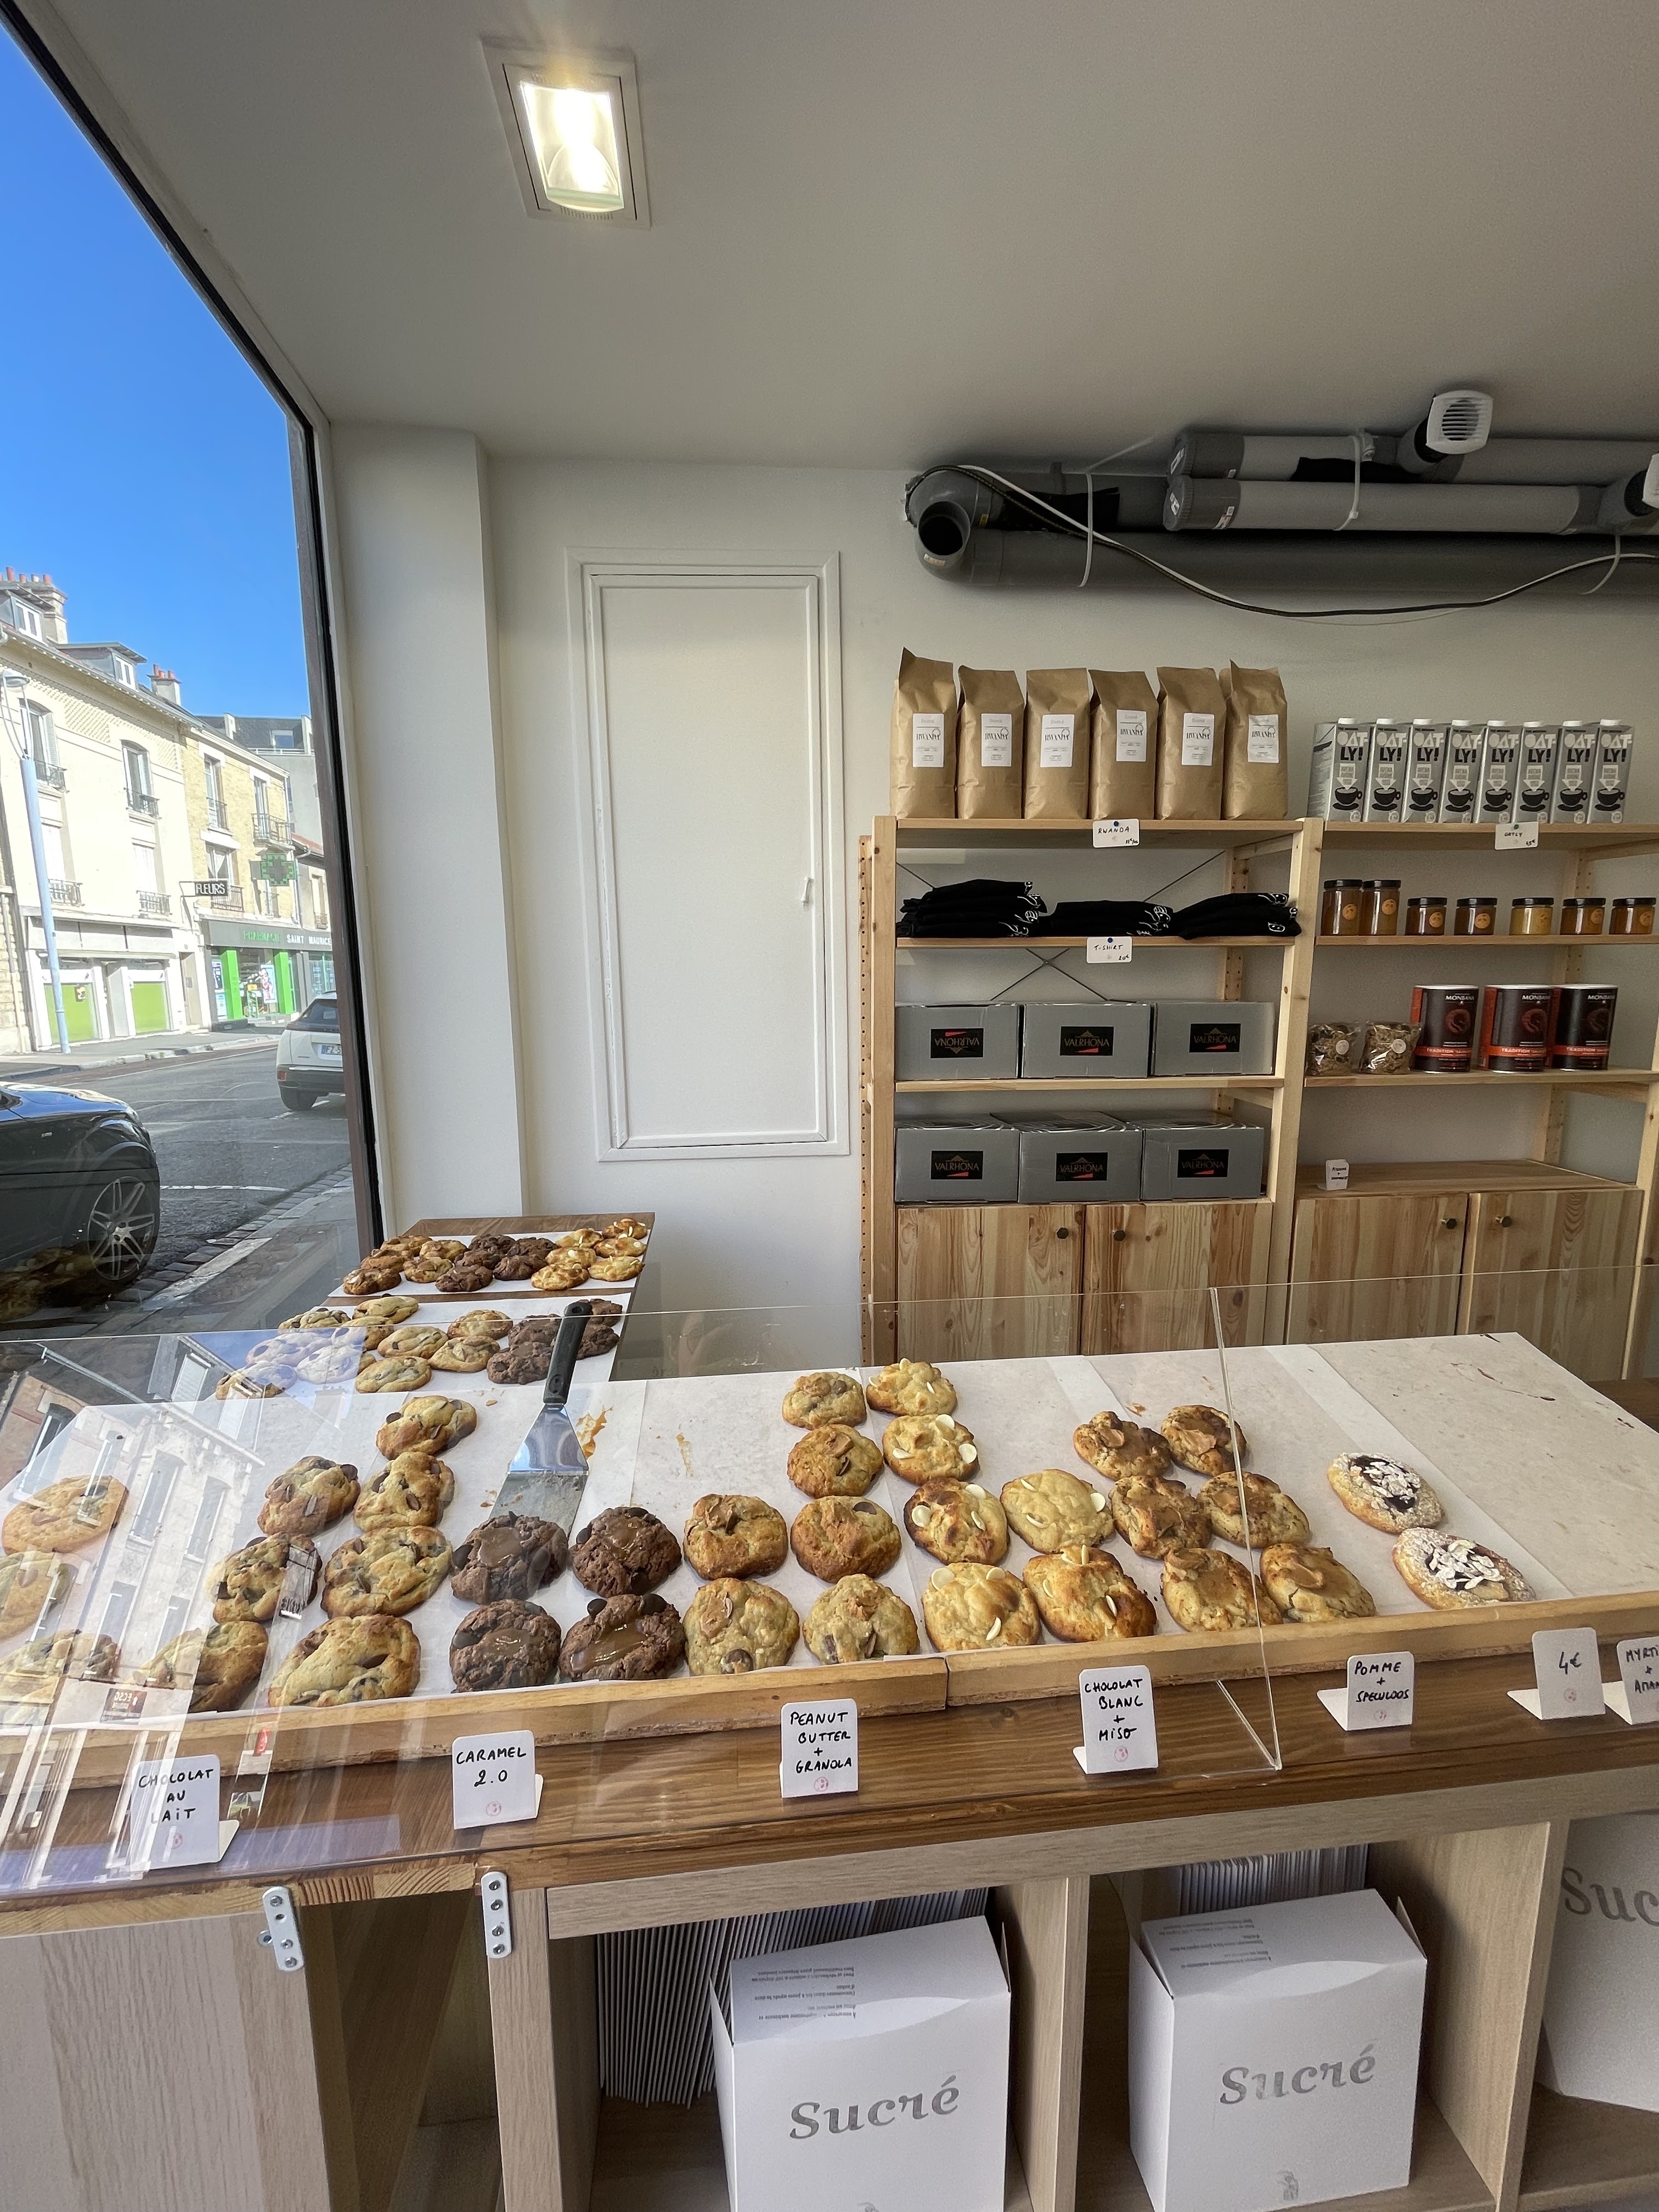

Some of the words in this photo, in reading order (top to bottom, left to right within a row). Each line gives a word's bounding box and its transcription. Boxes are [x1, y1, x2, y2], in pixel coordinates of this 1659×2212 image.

[1340, 747, 1363, 761] LY!
[1379, 747, 1402, 761] LY!
[1417, 747, 1439, 761] LY!
[1455, 749, 1477, 763] LY!
[1491, 748, 1514, 763] LY!
[1528, 749, 1551, 763] LY!
[1567, 748, 1590, 763] LY!
[1603, 748, 1627, 763] LY!
[195, 883, 225, 895] FLEURS
[287, 934, 304, 944] SAINT
[308, 936, 331, 945] MAURICE
[934, 1037, 980, 1046] VALRHONA
[1064, 1038, 1110, 1047] VALRHONA
[1194, 1035, 1237, 1043] VALRHONA
[935, 1162, 979, 1171] VALRHONA
[1060, 1163, 1103, 1172] VALRHONA
[1182, 1161, 1224, 1169] VALRHONA
[1355, 1661, 1401, 1675] POMME
[1559, 1651, 1582, 1675] 4€
[1376, 1677, 1385, 1685] +
[1098, 1695, 1143, 1709] BLANC
[1356, 1689, 1409, 1702] SPECULOOS
[790, 1711, 848, 1726] PEANUT
[1113, 1715, 1125, 1723] +
[798, 1730, 851, 1744] BUTTER
[456, 1747, 527, 1764] CARAMEL
[814, 1747, 823, 1757] +
[795, 1757, 852, 1774] GRANOLA
[139, 1768, 214, 1788] CHOCOLAT
[473, 1769, 507, 1787] 2.0
[166, 1790, 185, 1803] AU
[1220, 2044, 1375, 2105] Sucré
[789, 2074, 960, 2140] Sucré
